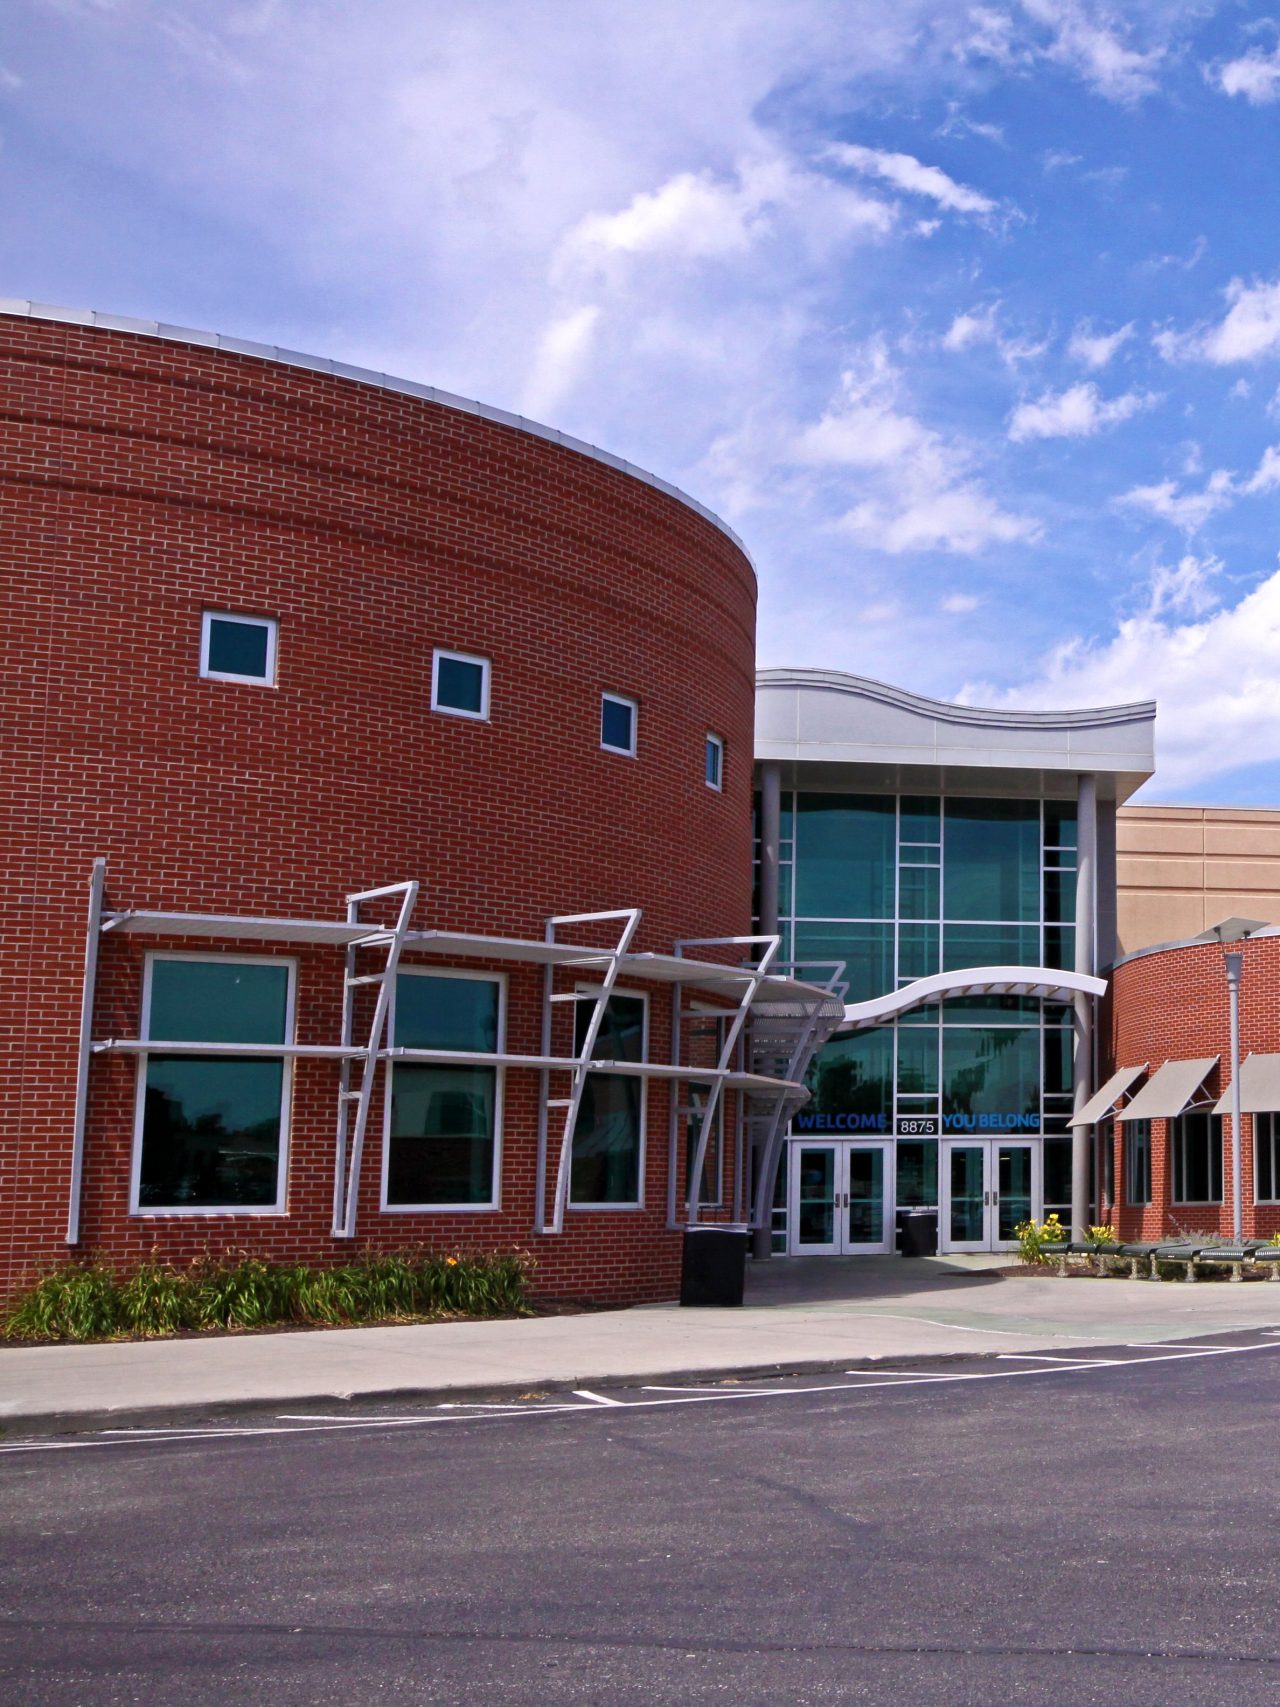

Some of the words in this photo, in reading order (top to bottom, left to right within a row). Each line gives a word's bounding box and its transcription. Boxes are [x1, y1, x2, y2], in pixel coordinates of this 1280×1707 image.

[799, 1113, 886, 1129] WELCOME
[900, 1120, 935, 1133] 8875
[943, 1113, 976, 1128] YOU
[978, 1113, 1040, 1128] BELONG
